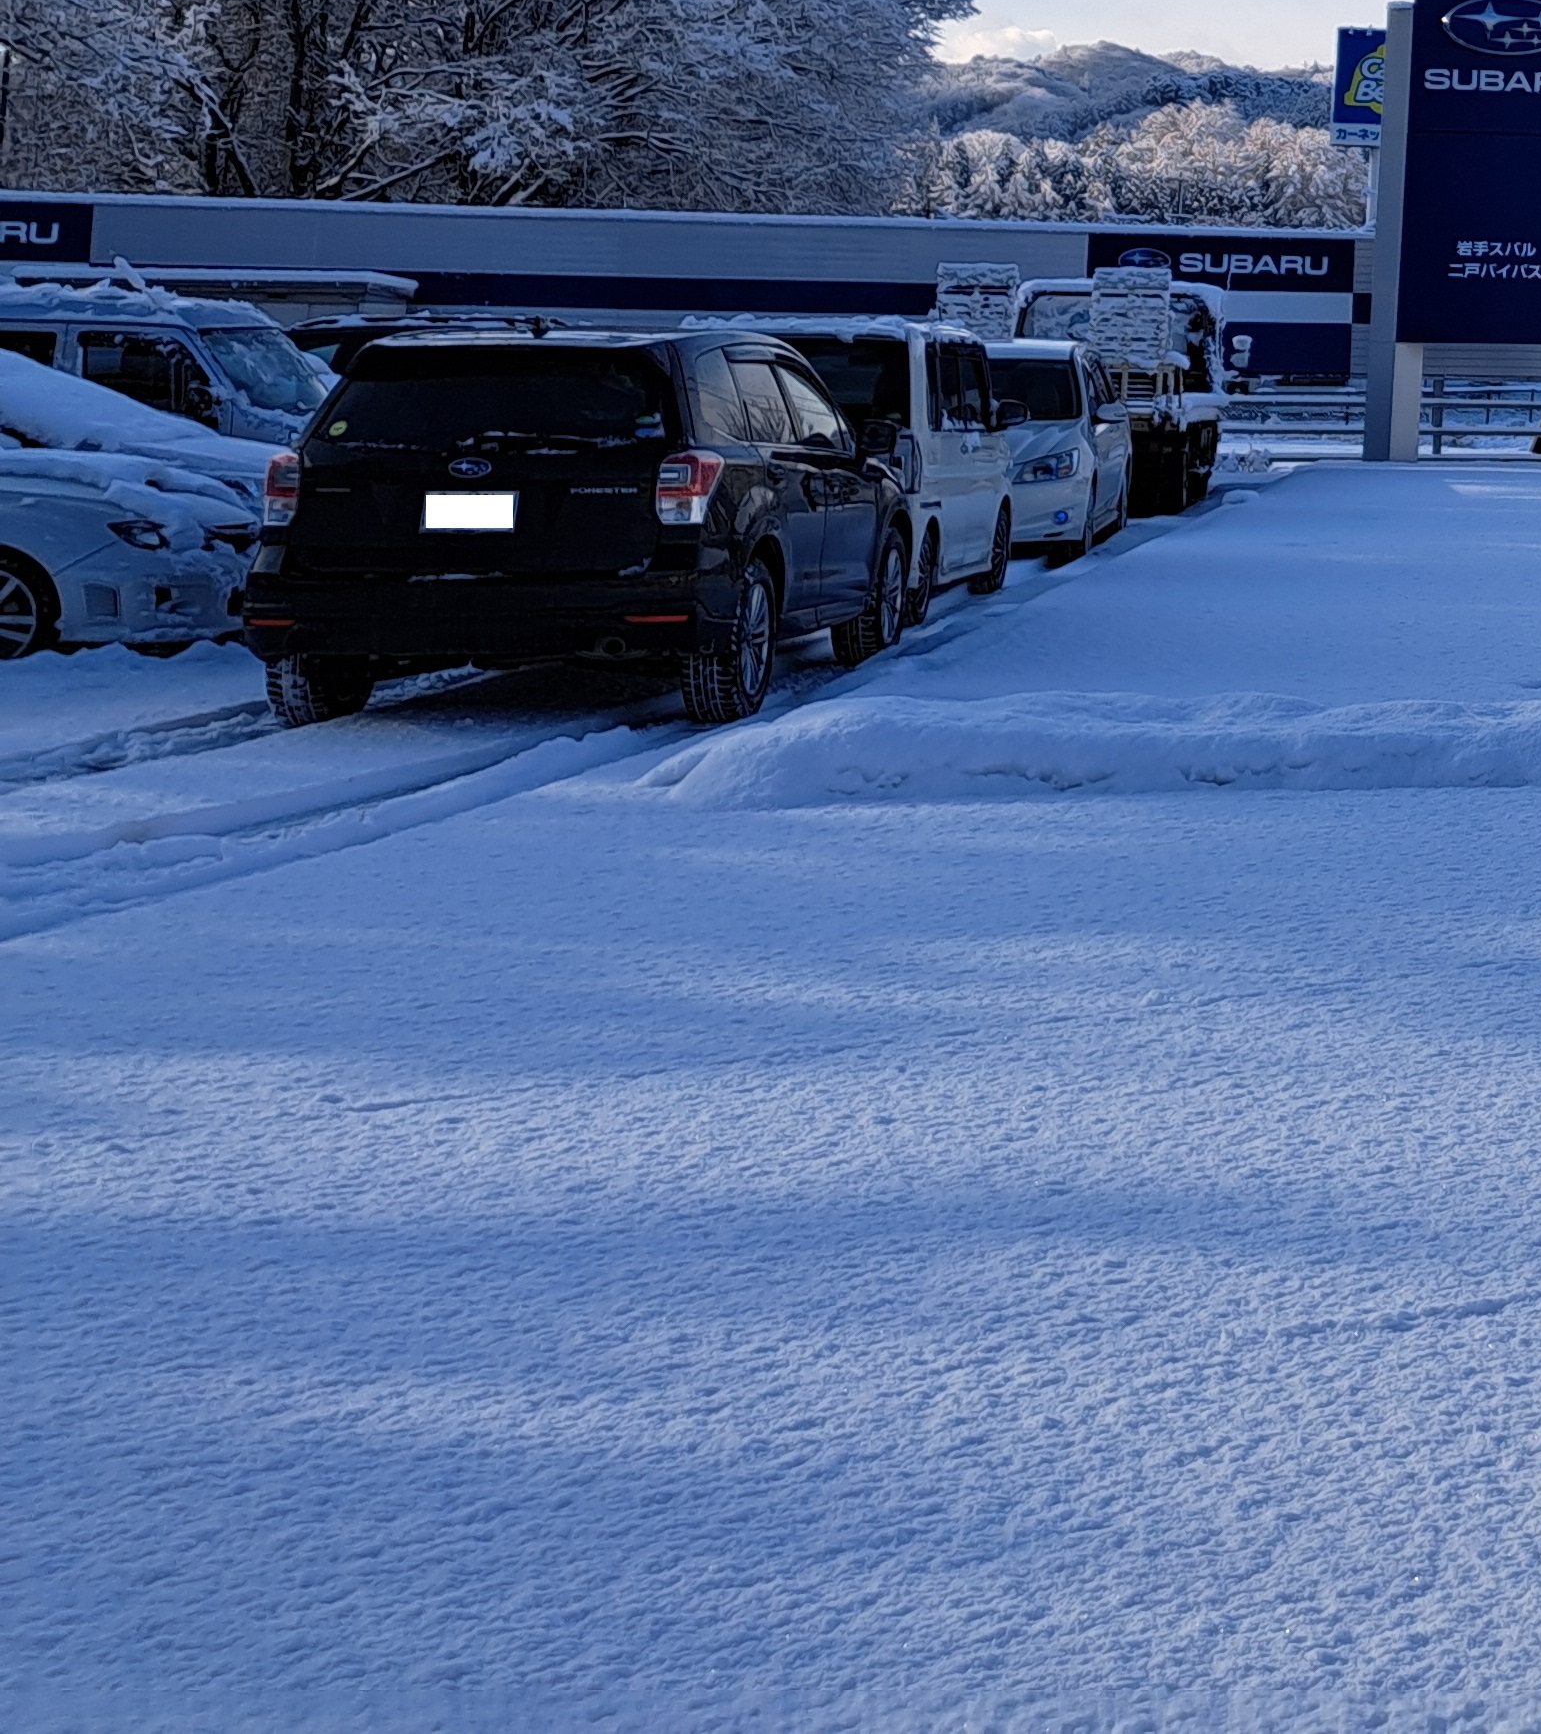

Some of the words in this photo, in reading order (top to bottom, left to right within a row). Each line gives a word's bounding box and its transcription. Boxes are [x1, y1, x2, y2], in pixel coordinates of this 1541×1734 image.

[1456, 240, 1537, 257] 岩手スバル
[1179, 252, 1329, 276] SUBARU
